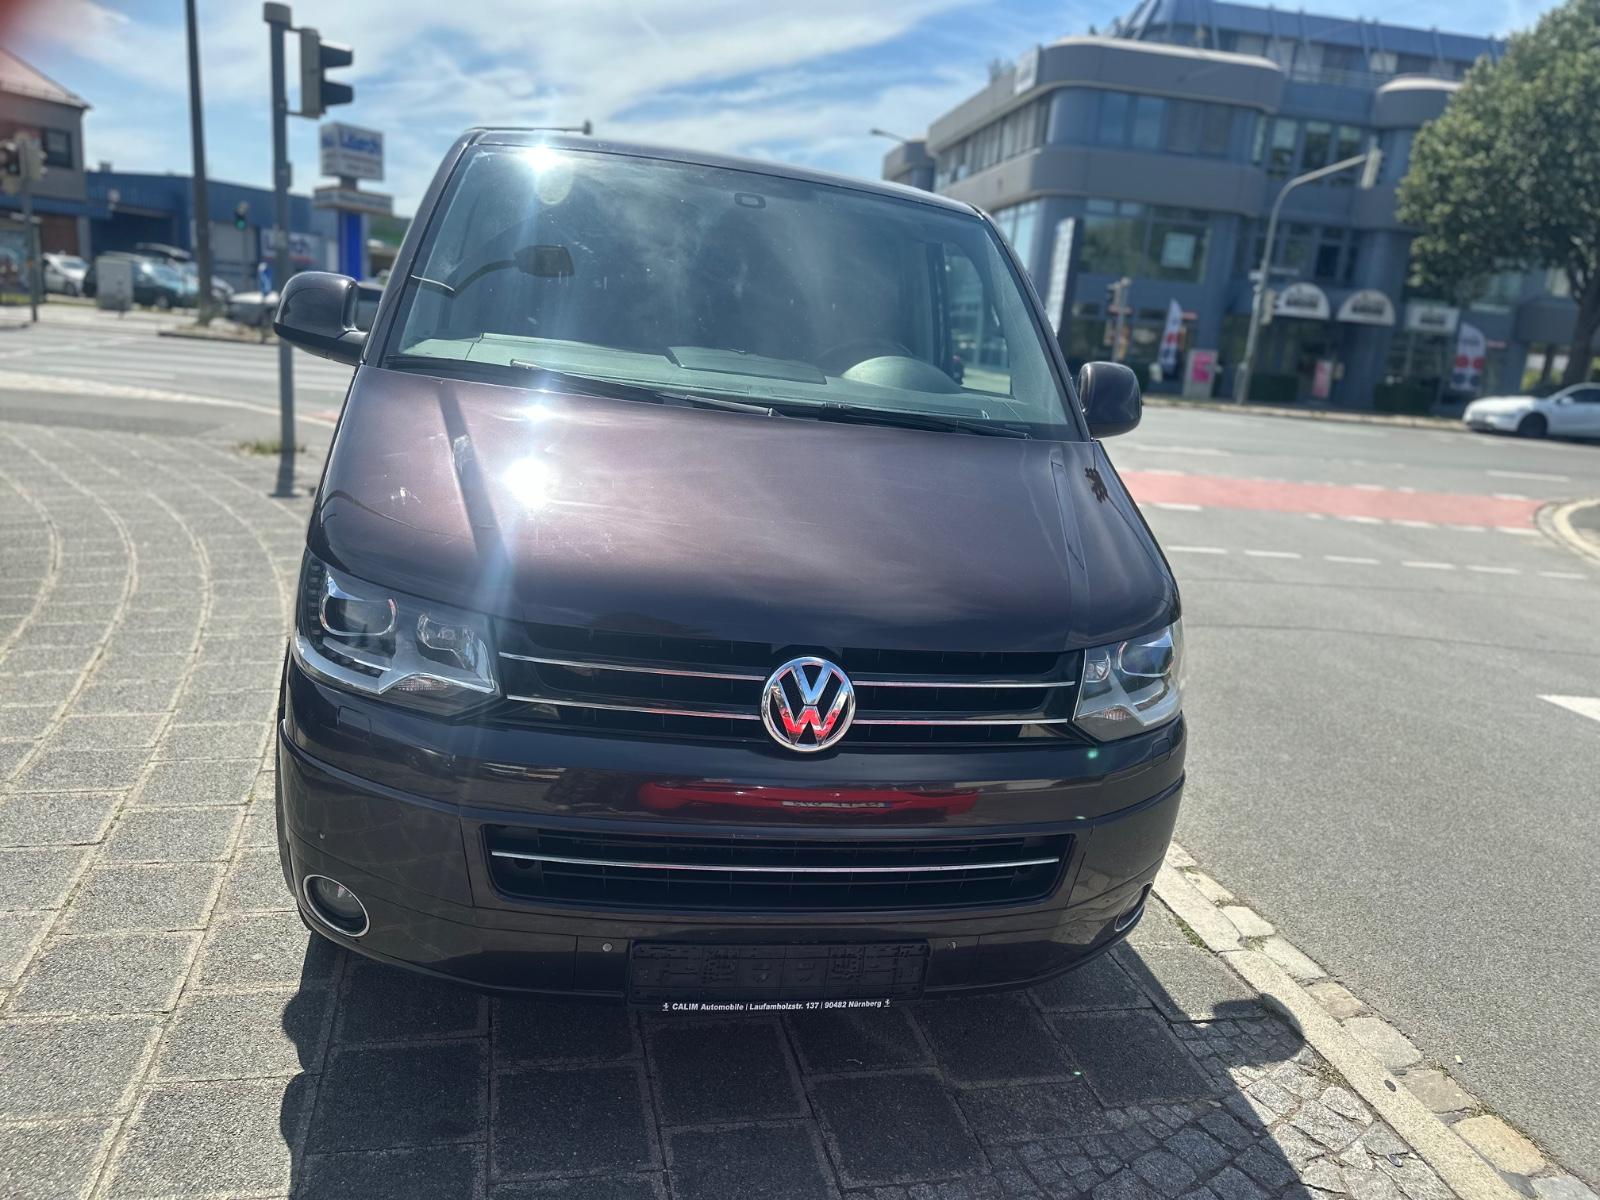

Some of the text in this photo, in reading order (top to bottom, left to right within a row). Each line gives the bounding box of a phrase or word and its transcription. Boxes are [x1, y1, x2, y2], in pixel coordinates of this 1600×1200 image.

[764, 659, 854, 750] VW
[672, 1003, 699, 1011] CALIM
[700, 1003, 744, 1011] Automobile
[824, 1001, 847, 1009] 90482
[848, 1000, 882, 1008] Nürnberg
